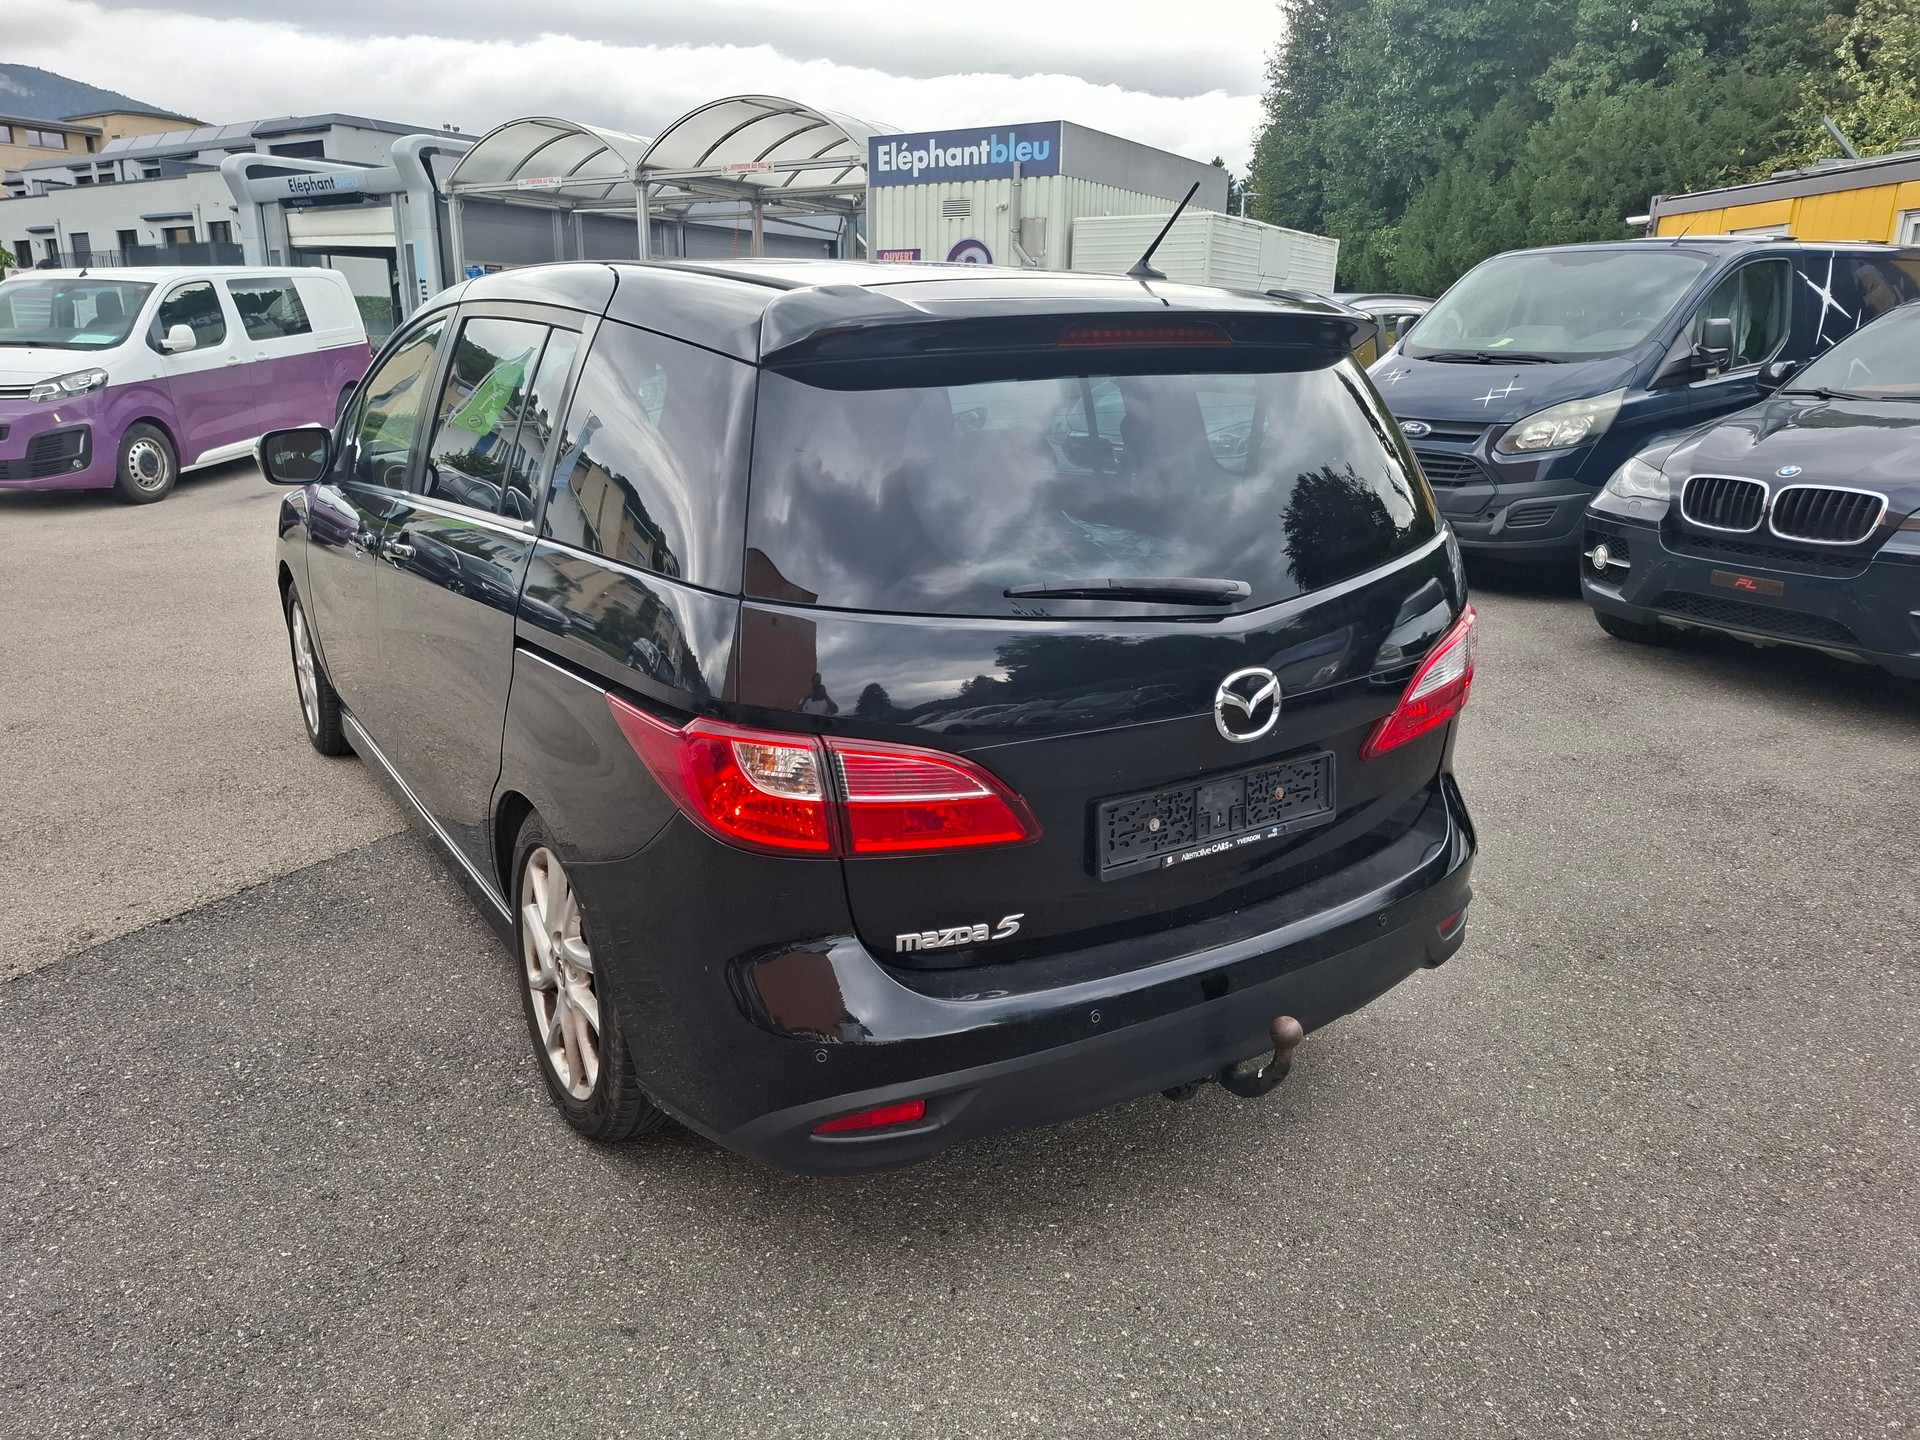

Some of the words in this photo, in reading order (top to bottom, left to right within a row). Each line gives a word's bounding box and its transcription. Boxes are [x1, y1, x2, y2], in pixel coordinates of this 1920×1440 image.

[883, 251, 915, 262] OUVERT
[1734, 578, 1757, 590] FL
[1236, 833, 1261, 846] YVERDON
[991, 912, 1026, 940] 5
